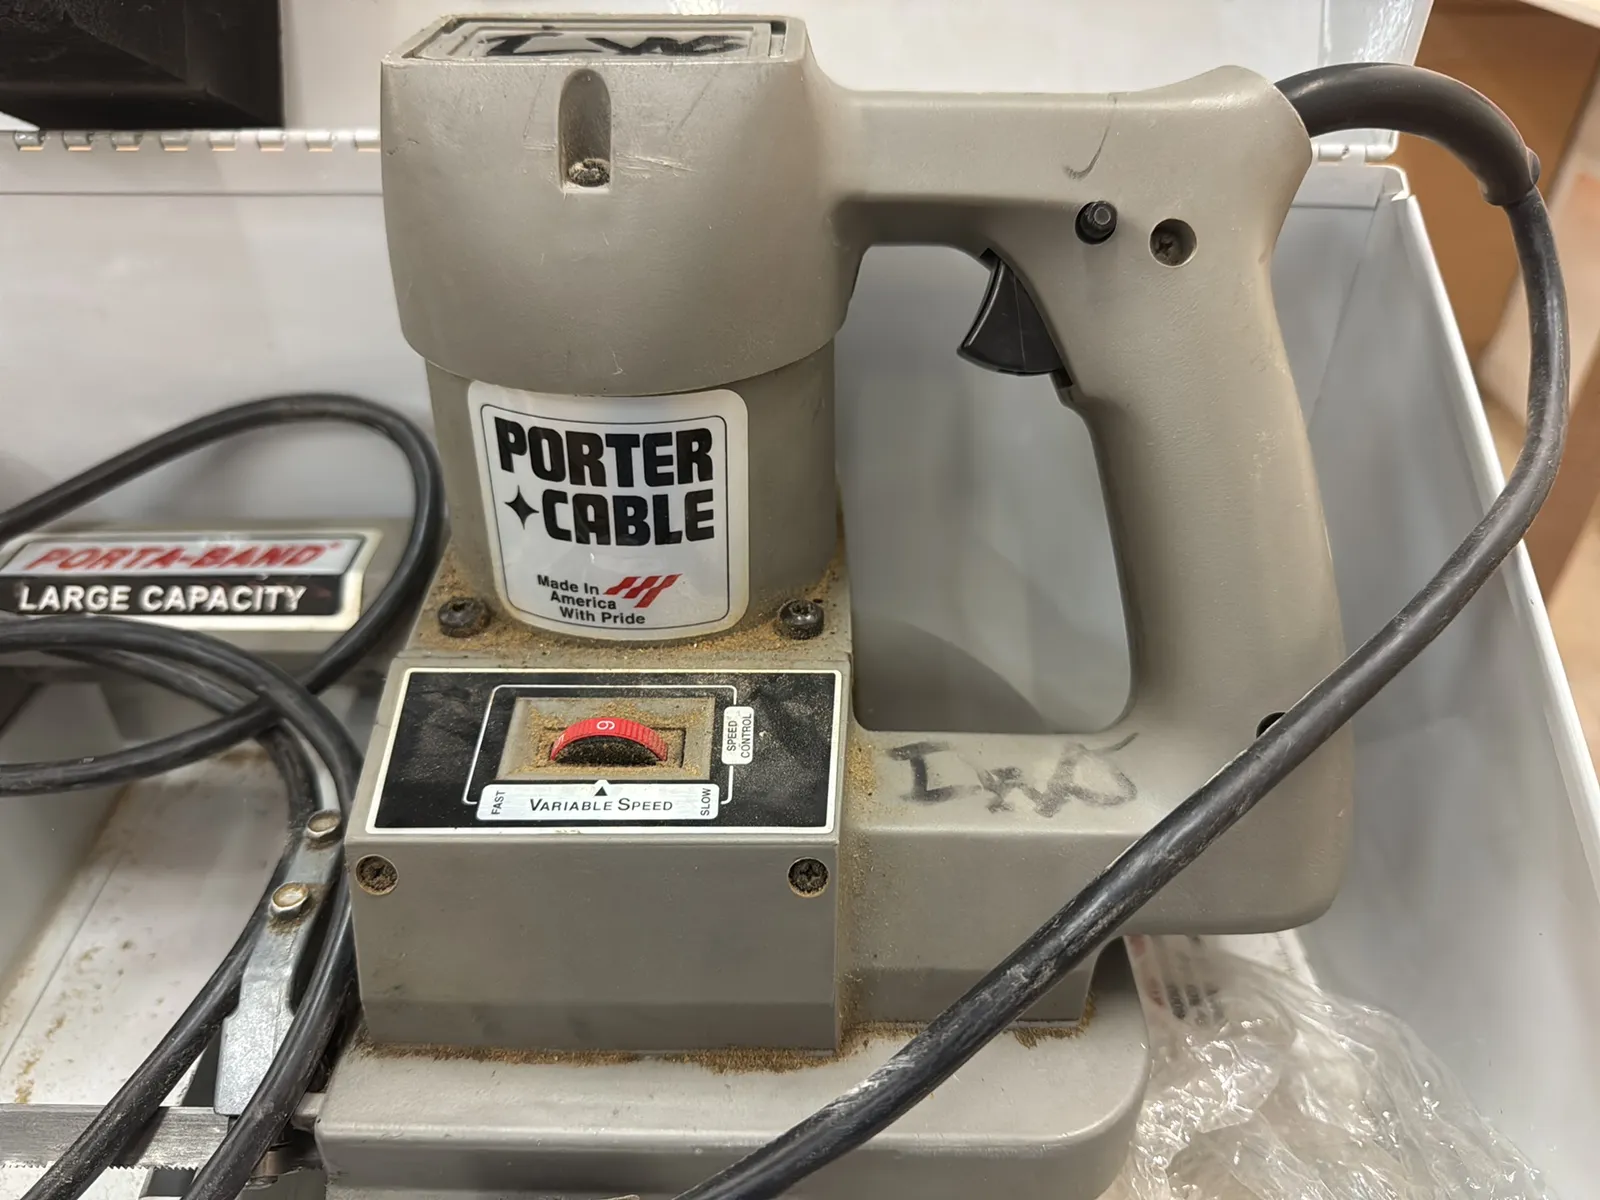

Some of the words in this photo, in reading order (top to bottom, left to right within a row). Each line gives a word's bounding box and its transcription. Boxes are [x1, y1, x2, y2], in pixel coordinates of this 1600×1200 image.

[494, 416, 714, 488] PORTER
[541, 488, 715, 546] CABLE
[18, 584, 132, 612] LARGE
[138, 584, 308, 612] CAPACITY
[537, 574, 579, 593] Made
[584, 582, 600, 596] In
[550, 590, 617, 610] America
[559, 605, 596, 622] With
[601, 611, 646, 625] Pride
[726, 720, 738, 752] SPEED
[740, 713, 752, 758] CONTROL
[491, 790, 506, 815] FAST
[530, 798, 613, 812] VARIABLE
[617, 797, 673, 812] SPEED
[699, 787, 712, 816] SLOW
